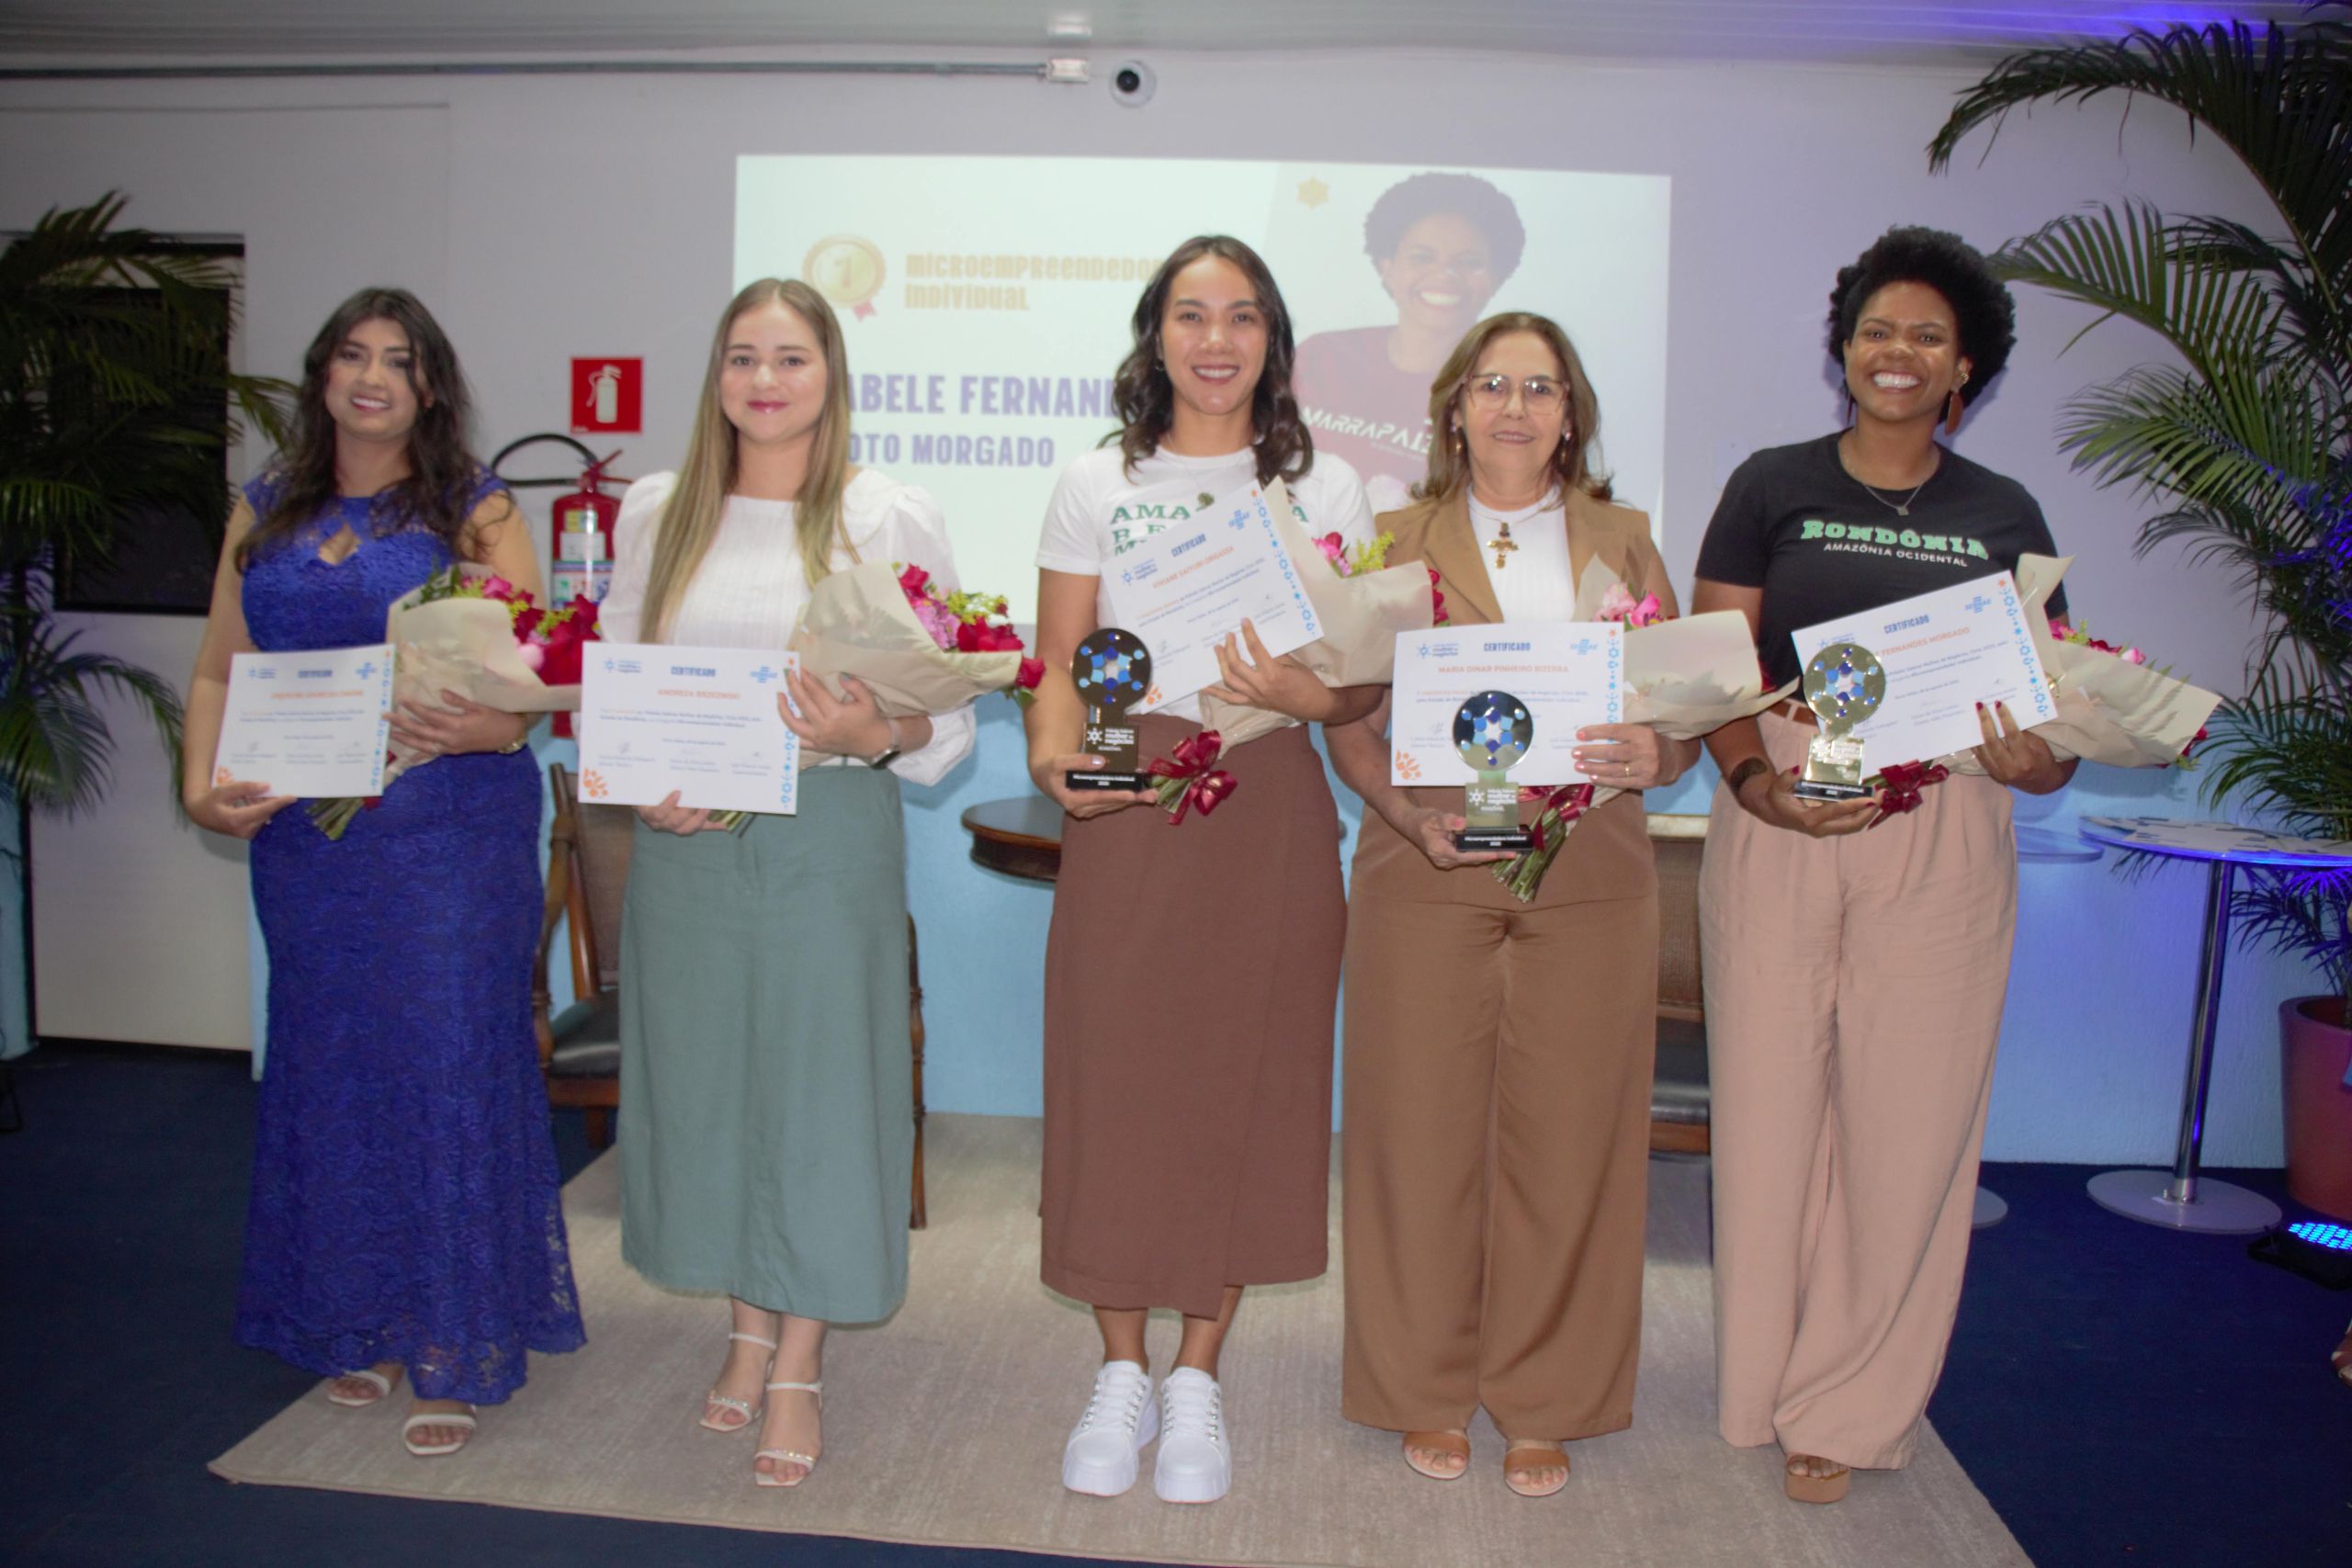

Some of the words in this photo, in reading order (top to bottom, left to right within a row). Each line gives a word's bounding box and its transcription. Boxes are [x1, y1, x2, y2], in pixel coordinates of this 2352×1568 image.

[911, 434, 1055, 468] MORGADO
[1171, 534, 1206, 558] CERTIFICADO
[1801, 520, 1988, 560] RONDÔNIA
[1823, 543, 1893, 557] AMAZÔNIA
[1895, 549, 1968, 567] OCIDENTAL
[1884, 615, 1930, 635] CERTIFICADO
[1484, 643, 1531, 651] CERTIFICADO
[1882, 638, 1928, 656] FERNANDES
[1929, 626, 1970, 643] MORGADO
[671, 666, 716, 678] CERTIFICADO
[1494, 665, 1532, 673] PINHEIRO
[1534, 665, 1568, 673] BIZERRA
